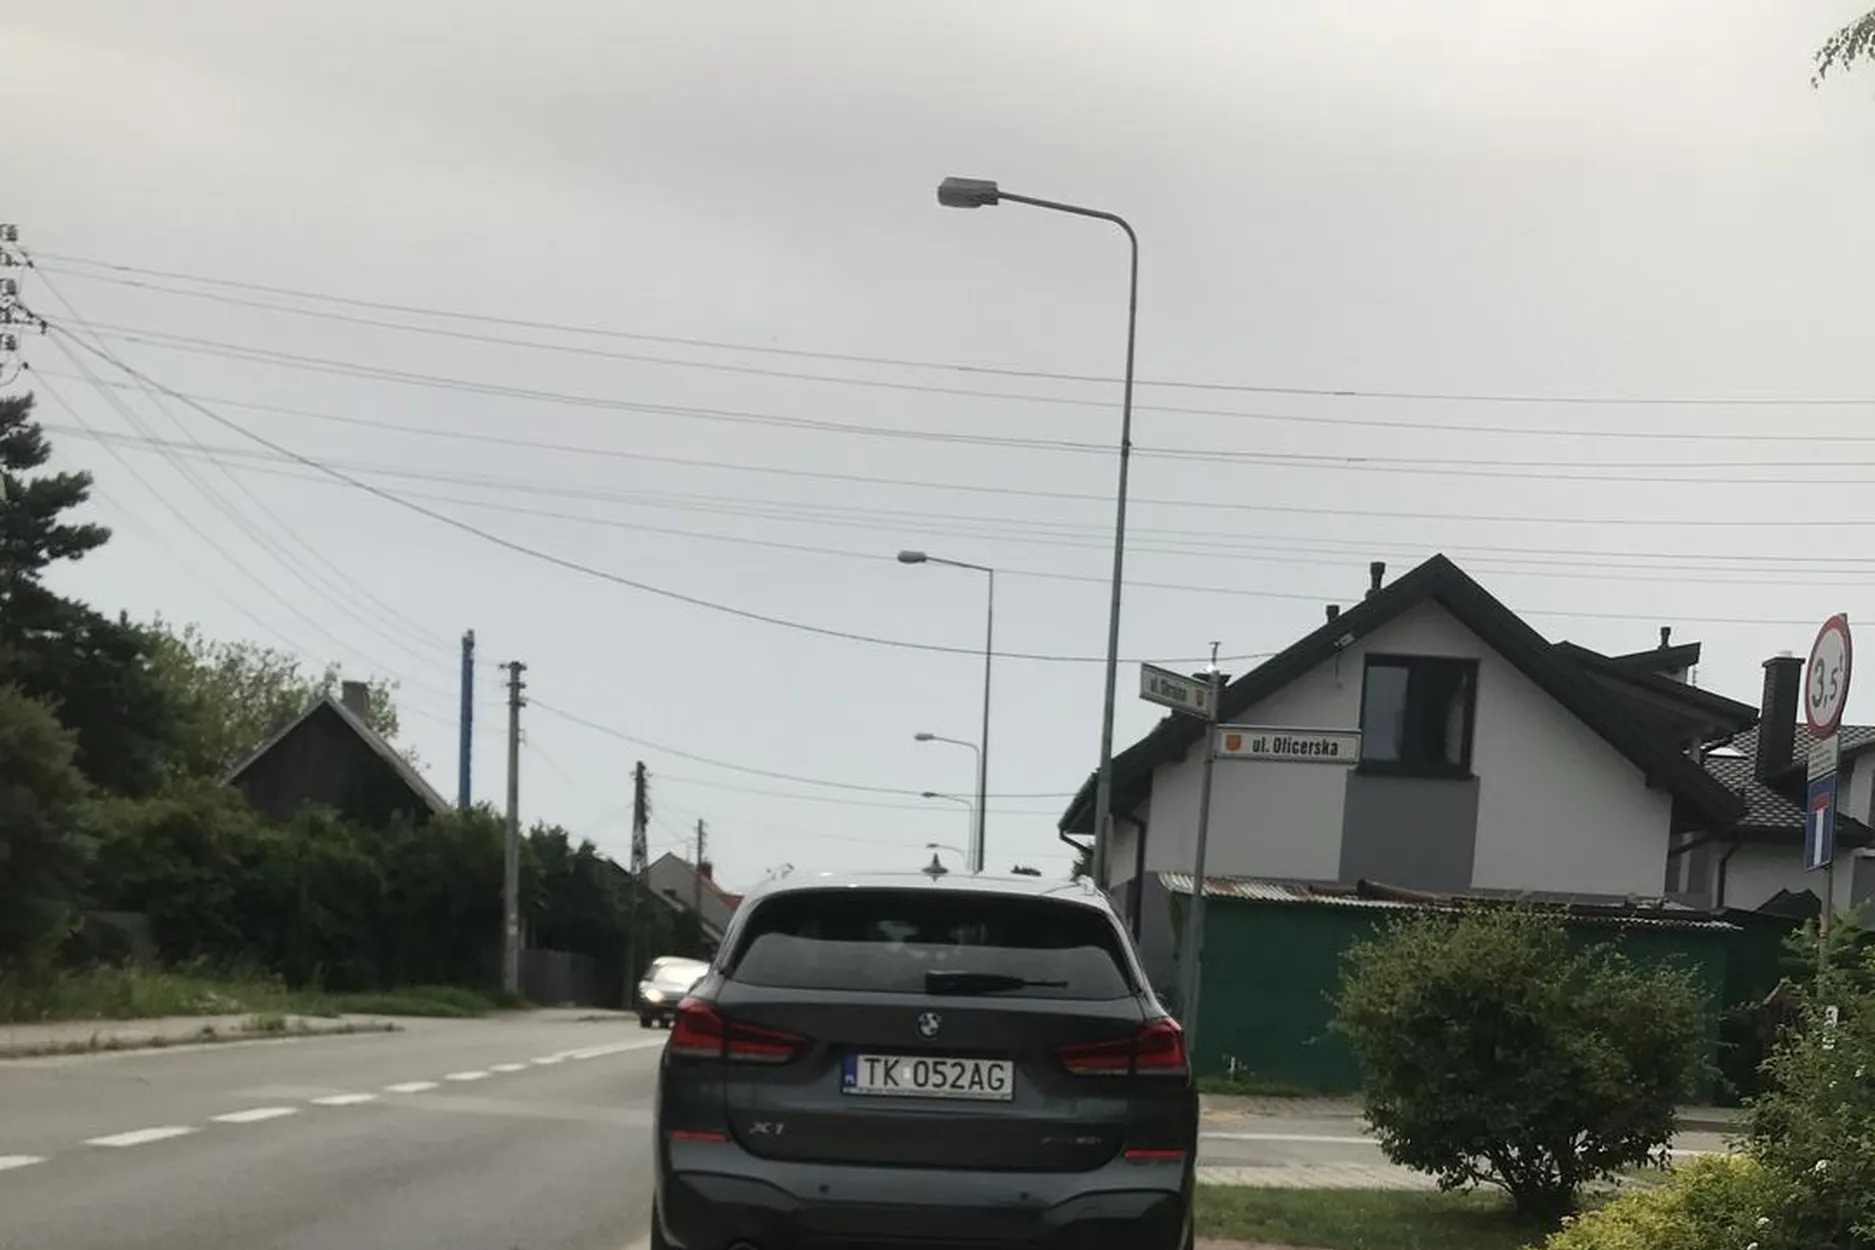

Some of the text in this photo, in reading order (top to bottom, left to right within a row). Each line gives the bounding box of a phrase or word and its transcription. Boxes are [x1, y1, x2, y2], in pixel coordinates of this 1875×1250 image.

[1252, 736, 1269, 753] ul.
[863, 1057, 1005, 1091] TK 052AG
